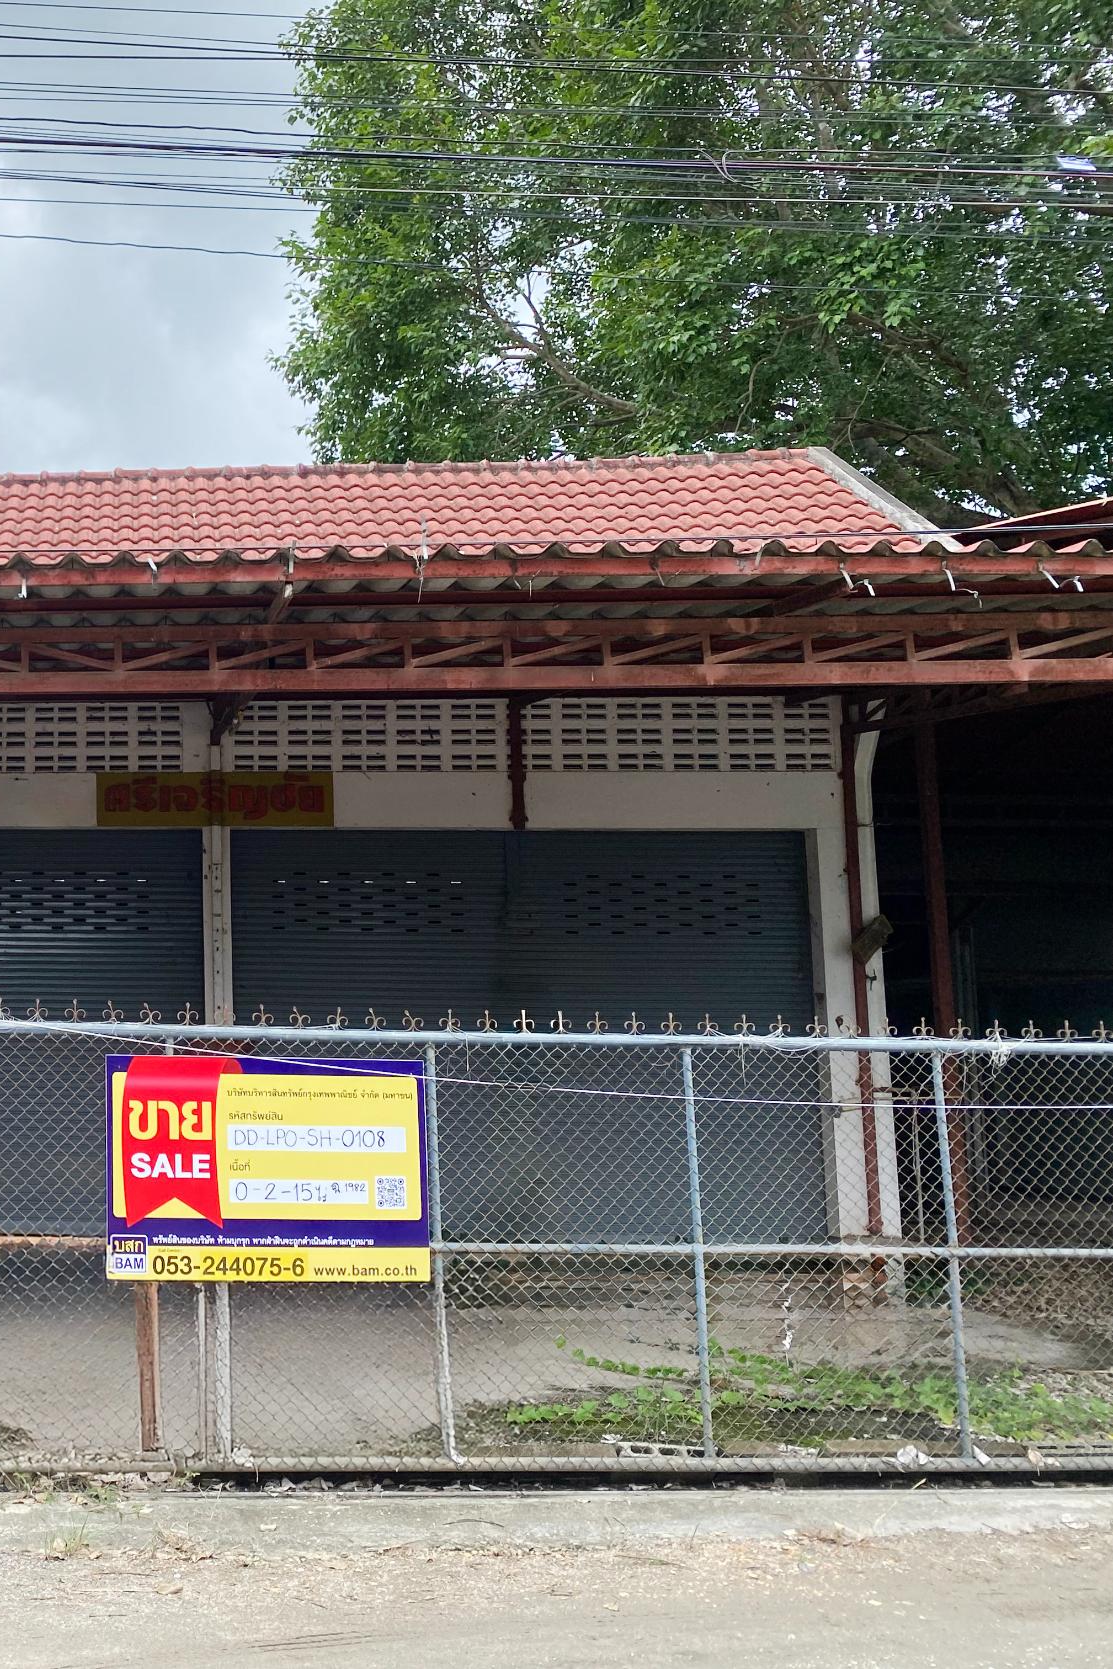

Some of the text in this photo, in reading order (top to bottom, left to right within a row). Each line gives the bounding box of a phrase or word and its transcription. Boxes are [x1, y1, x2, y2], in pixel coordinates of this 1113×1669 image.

[103, 771, 326, 820] ศรีเจริญชัย
[360, 1090, 380, 1100] จำกัด
[382, 1091, 413, 1101] (มหาชน)
[128, 1099, 212, 1140] ขาย
[130, 1152, 211, 1178] SALE
[229, 1158, 251, 1172] เนื้อที่
[114, 1240, 144, 1253] บสก
[152, 1233, 215, 1245] ทรัพย์สินของบริษัท
[217, 1234, 250, 1248] ห้ามบุกรุก
[115, 1257, 144, 1270] BAM
[152, 1255, 418, 1277] 053-244075-6 www.bam.co.th
